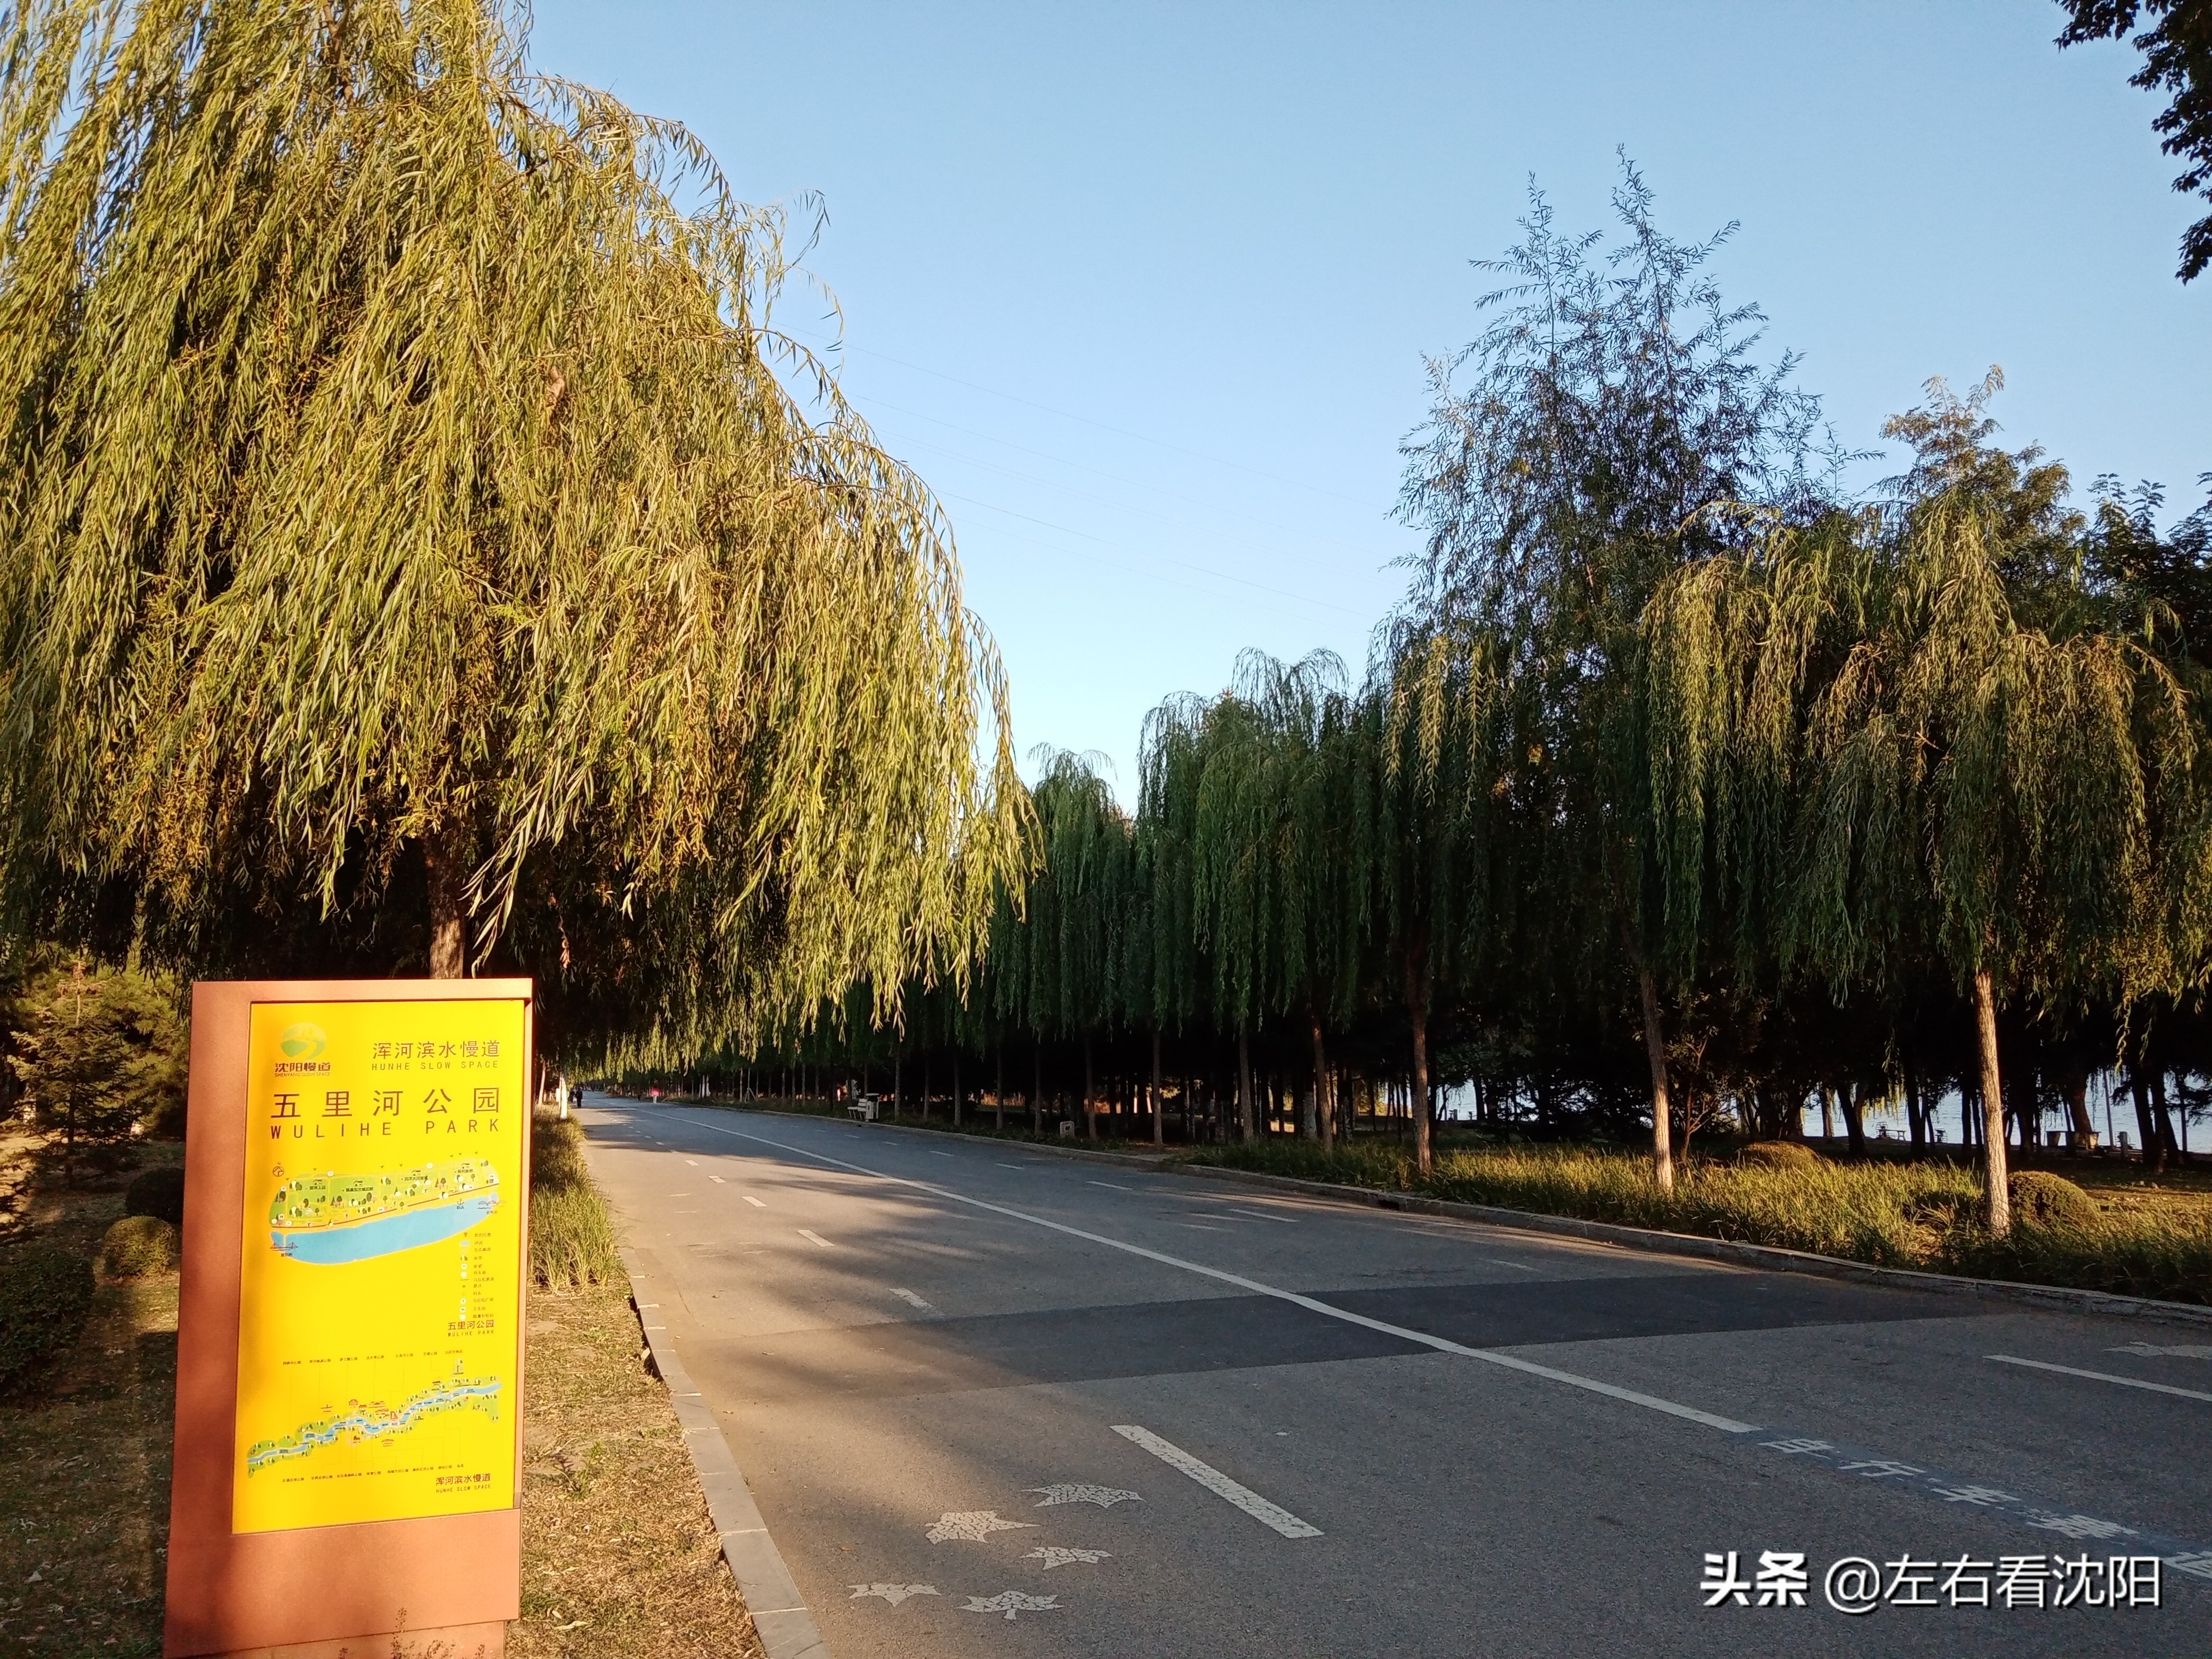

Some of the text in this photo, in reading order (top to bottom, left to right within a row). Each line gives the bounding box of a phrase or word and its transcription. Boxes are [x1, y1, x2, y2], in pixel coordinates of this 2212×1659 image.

[373, 1040, 500, 1059] 浑河滨水慢道
[275, 1062, 330, 1072] 沈阳慢道
[271, 1087, 499, 1118] 五里河公园
[271, 1119, 499, 1139] WULIHE PARK
[448, 1319, 494, 1330] 五里河公园
[435, 1473, 491, 1486] 浑河滨水慢道
